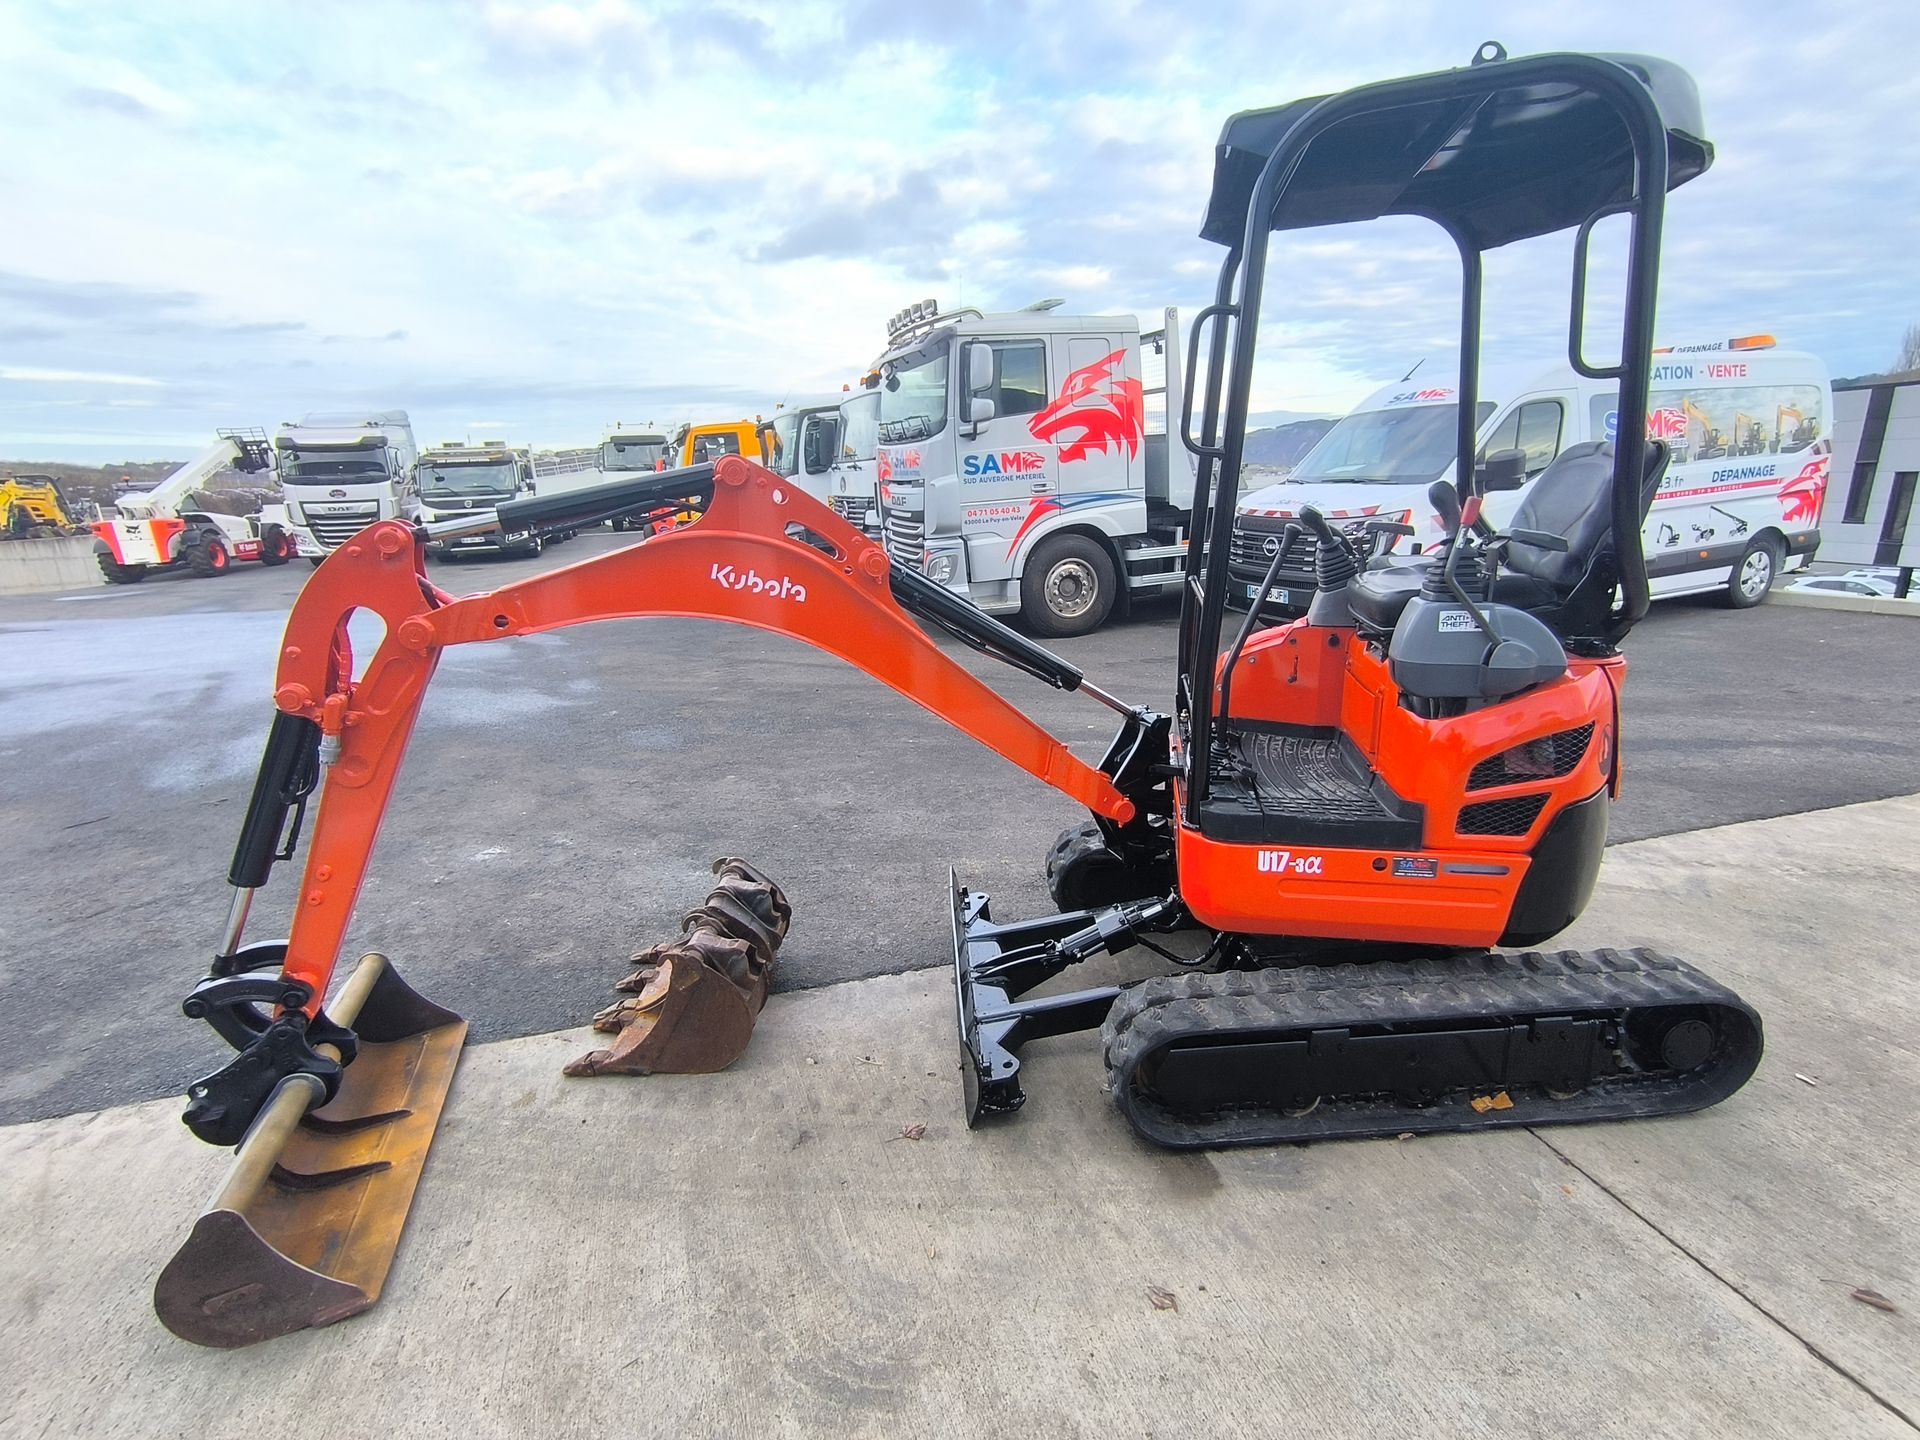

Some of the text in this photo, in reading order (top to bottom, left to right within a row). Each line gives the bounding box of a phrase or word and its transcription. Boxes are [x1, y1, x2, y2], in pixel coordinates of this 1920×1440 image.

[1707, 364, 1747, 378] VENTE
[964, 452, 1022, 475] SAM
[963, 472, 1046, 485] SUD AUVERGNE MATERIEL
[892, 496, 907, 507] DAF
[711, 563, 807, 602] Kubota
